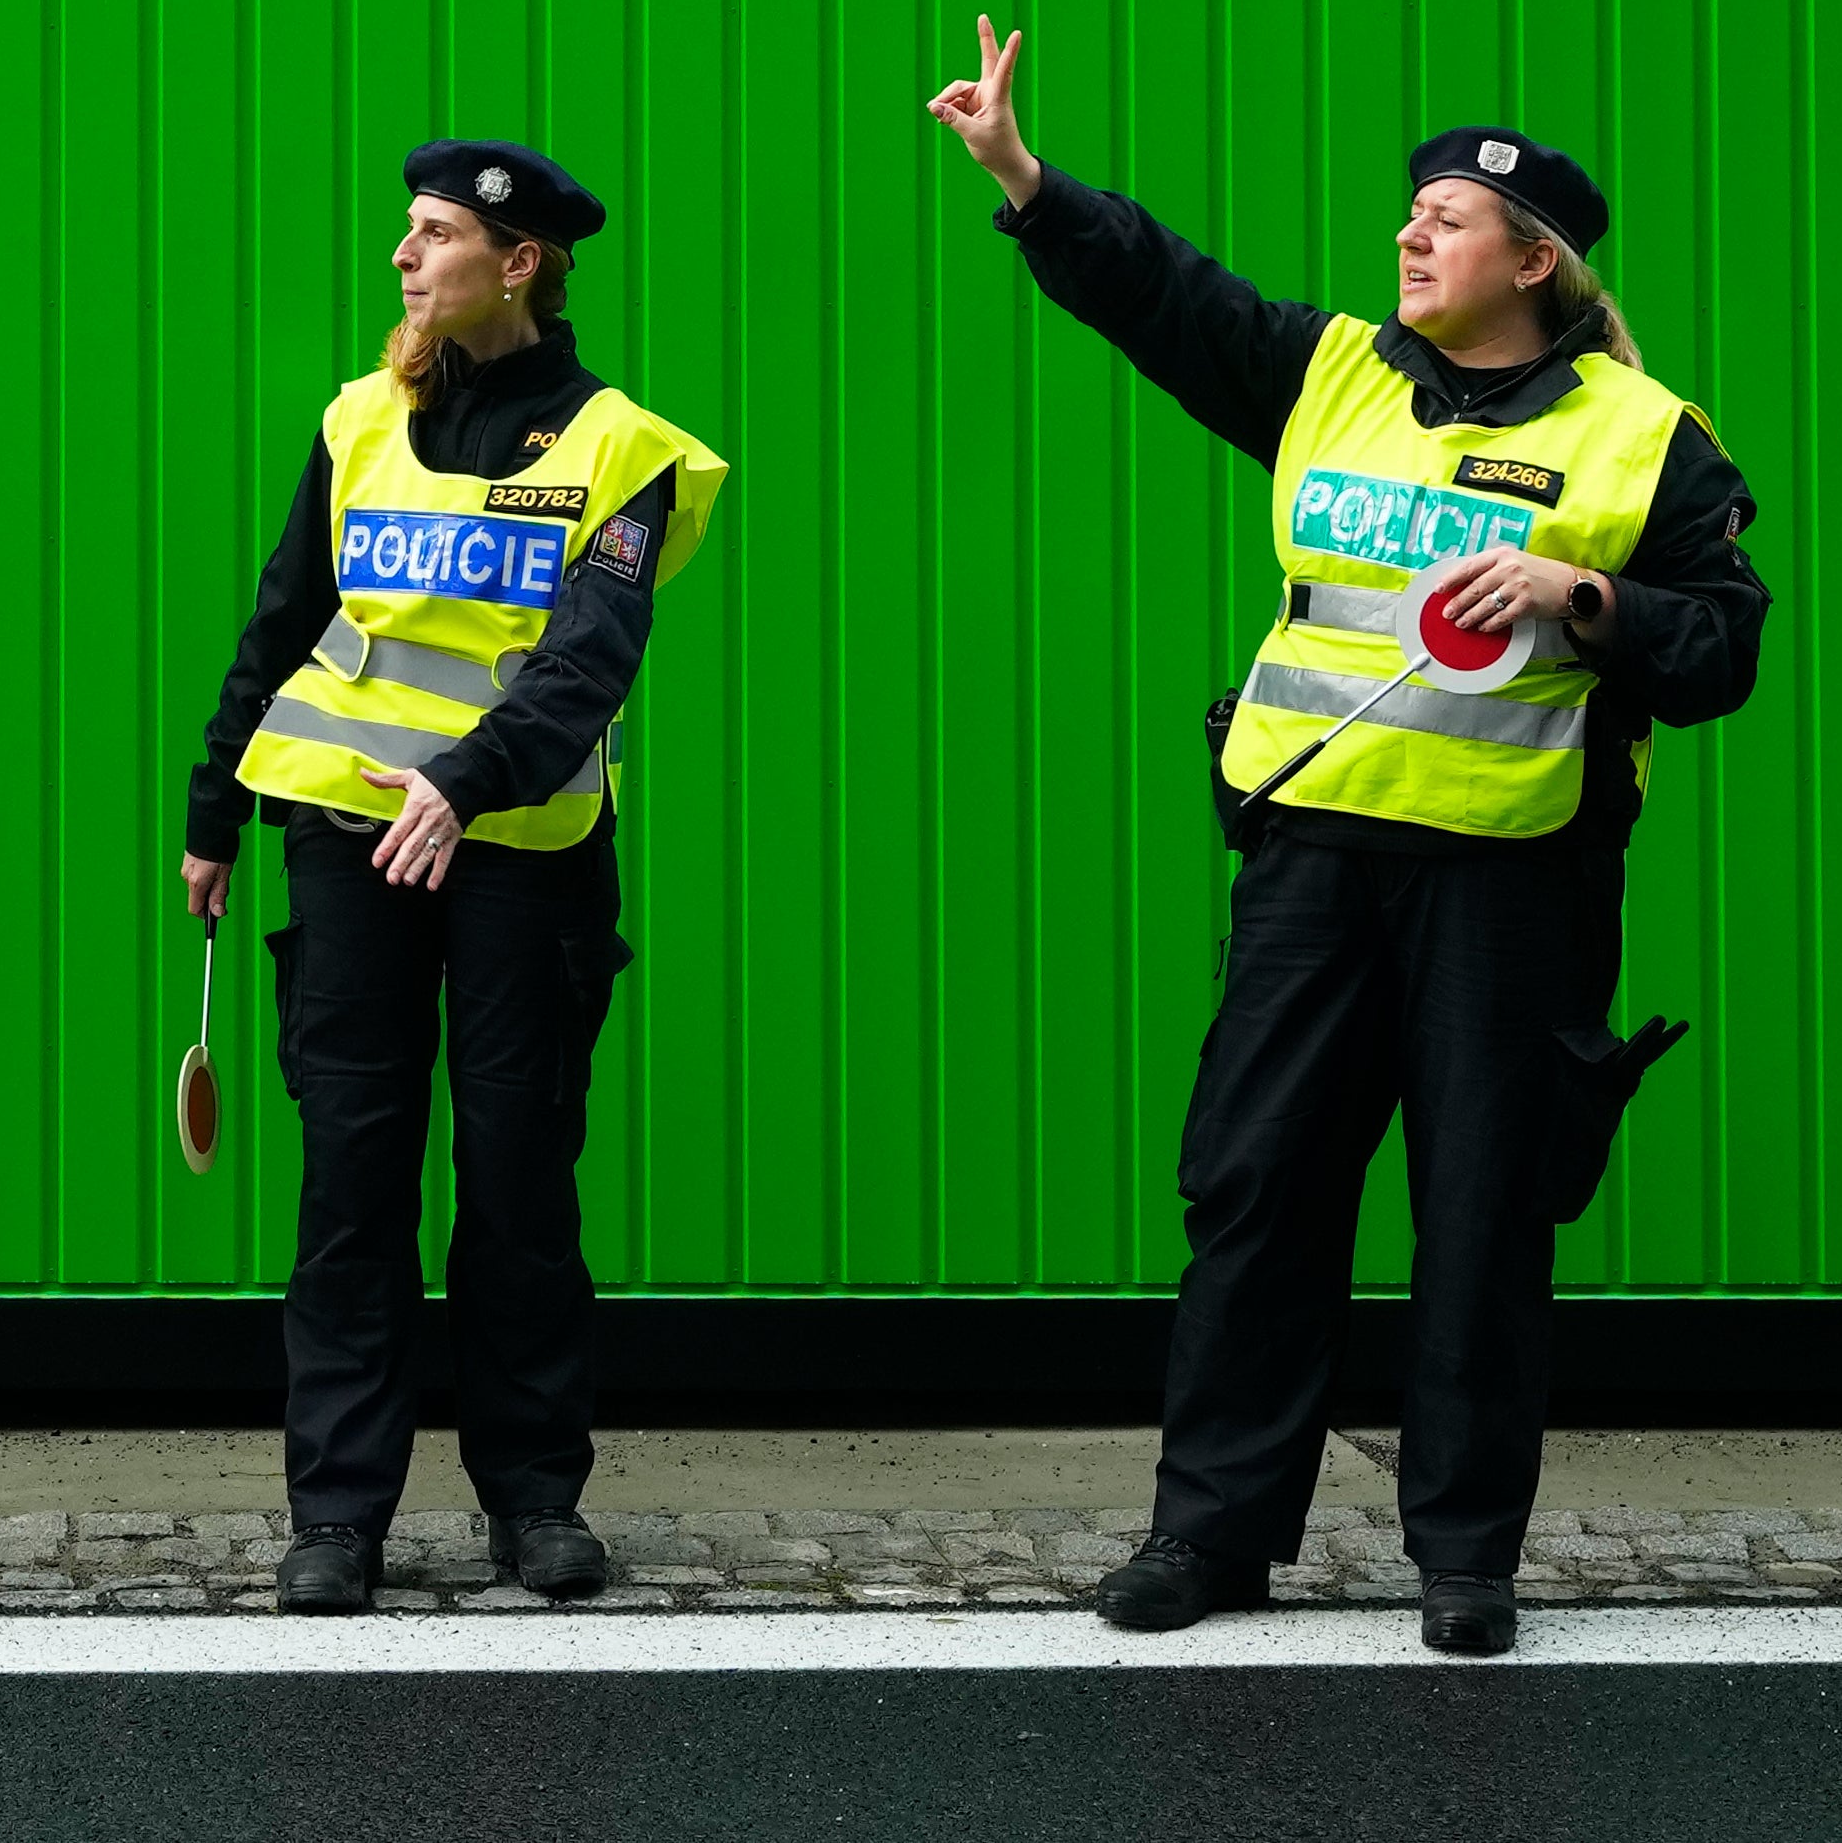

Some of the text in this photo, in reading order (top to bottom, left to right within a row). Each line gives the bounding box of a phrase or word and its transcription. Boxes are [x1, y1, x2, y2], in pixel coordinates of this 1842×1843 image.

[1468, 461, 1552, 491] 324266
[488, 488, 585, 509] 320782
[342, 524, 558, 594] POLICIE
[595, 554, 635, 576] POLICIE
